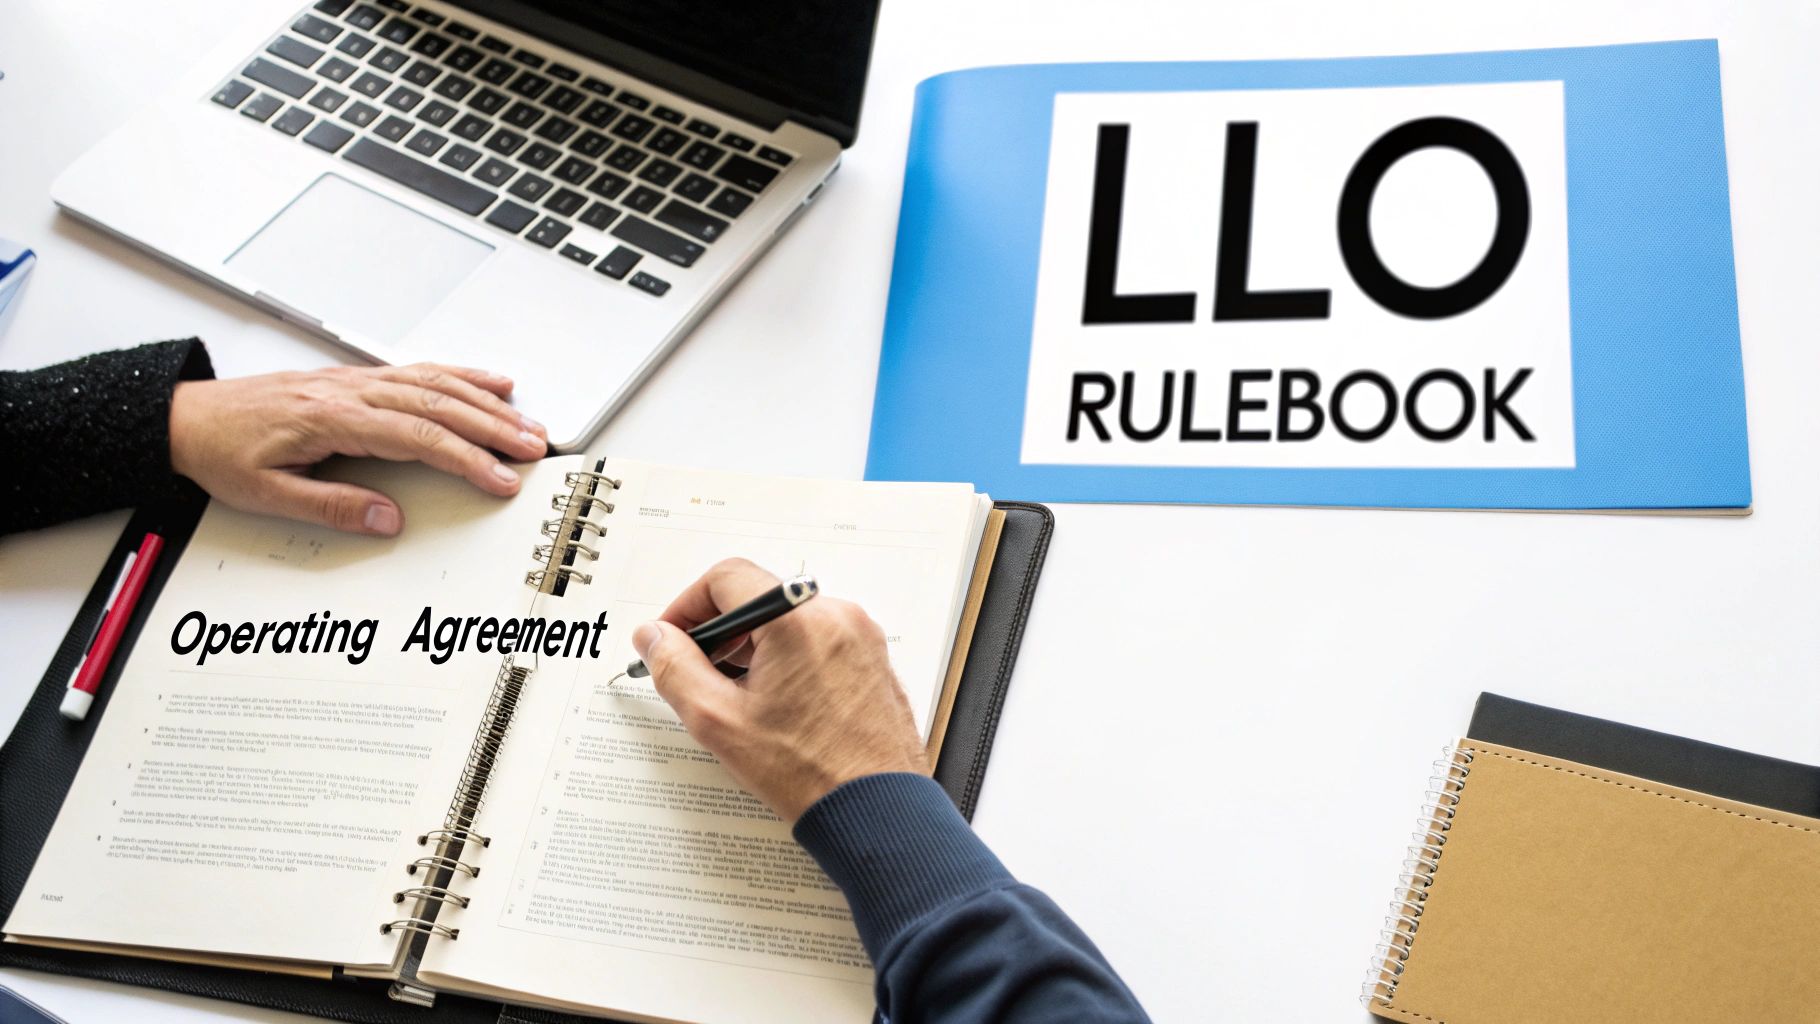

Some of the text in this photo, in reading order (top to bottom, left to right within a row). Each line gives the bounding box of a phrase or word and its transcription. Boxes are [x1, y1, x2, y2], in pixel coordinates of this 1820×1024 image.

[1081, 115, 1532, 326] LLO
[1066, 368, 1536, 443] RULEBOOK
[170, 606, 609, 666] Operating Agreement
